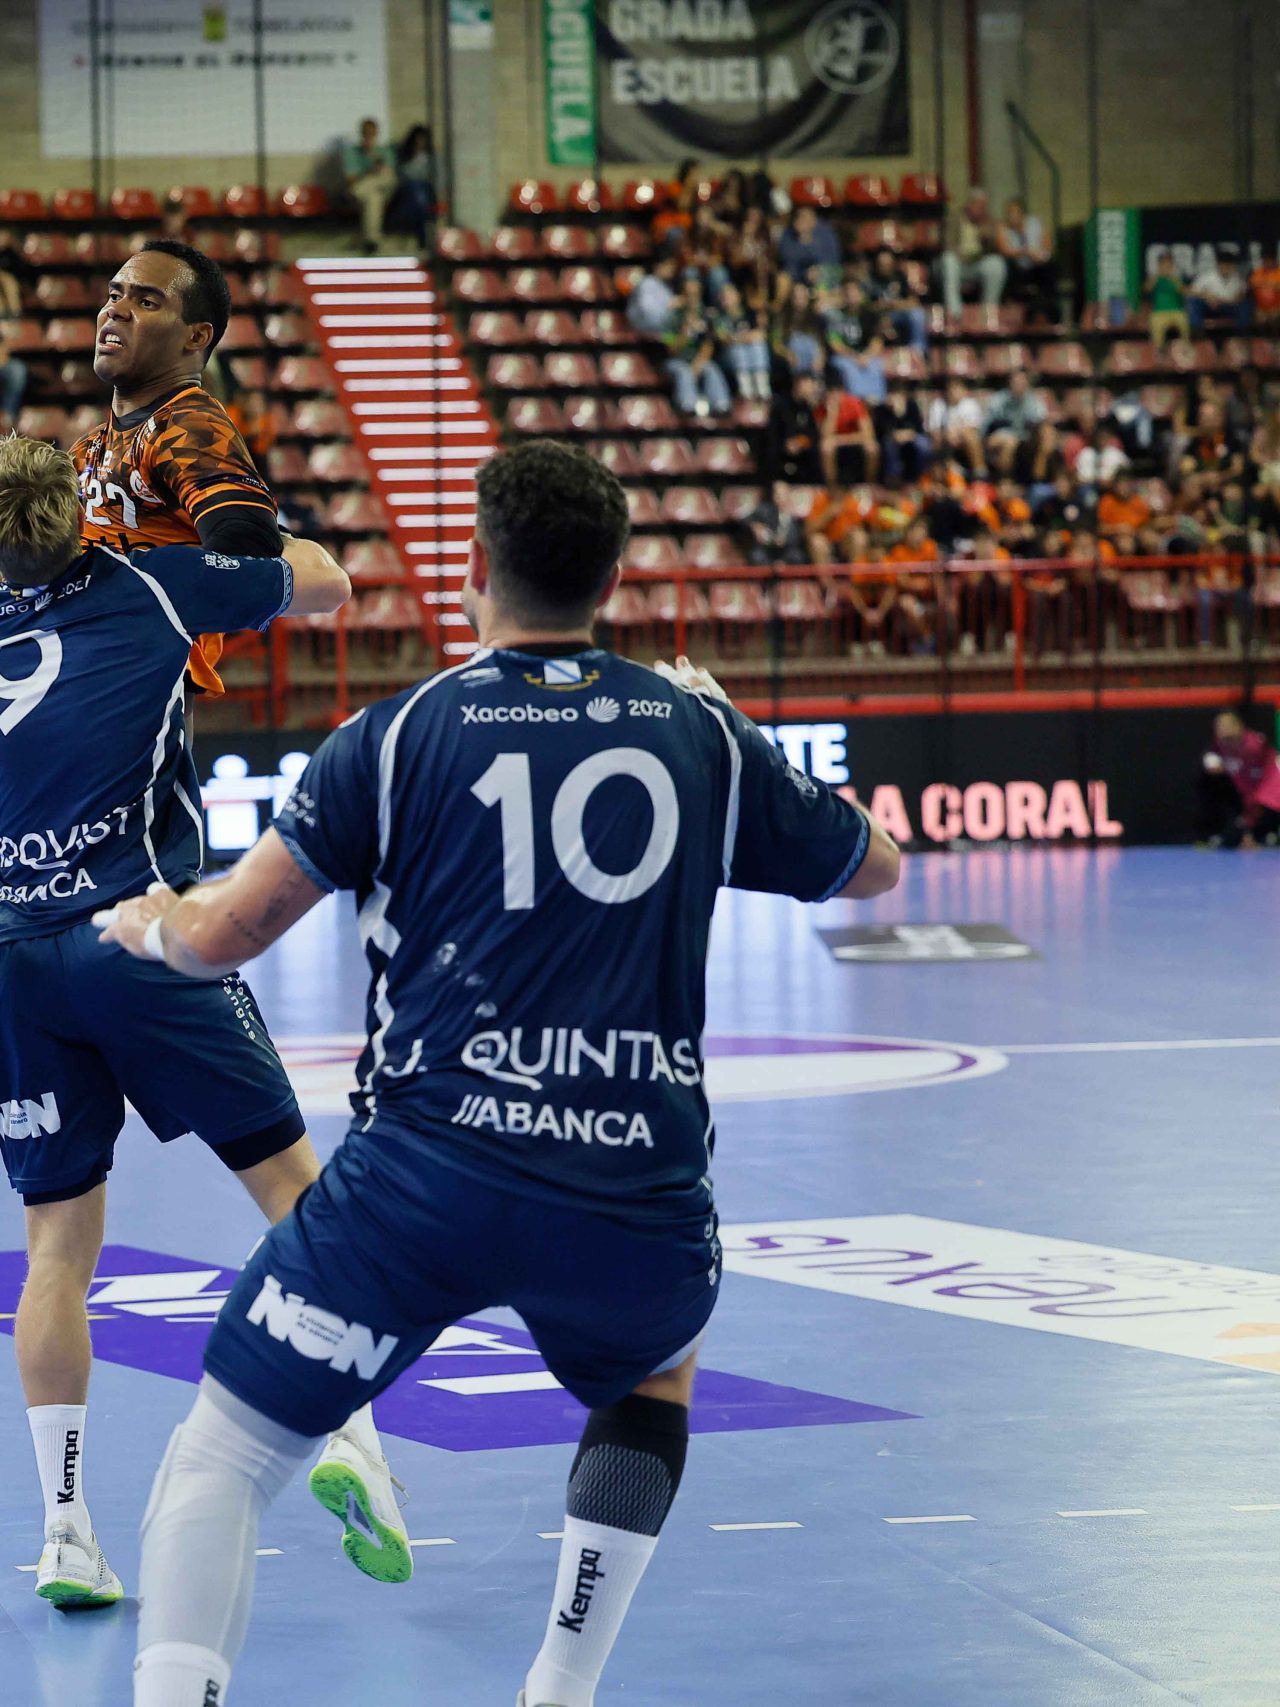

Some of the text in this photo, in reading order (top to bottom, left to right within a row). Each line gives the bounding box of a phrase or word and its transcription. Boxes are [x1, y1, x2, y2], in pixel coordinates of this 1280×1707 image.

[612, 56, 801, 106] ESCUELA
[84, 478, 139, 529] 27
[459, 699, 673, 725] Xacobeo 2027
[469, 746, 680, 911] 10
[920, 779, 1124, 842] CORAL
[460, 1026, 702, 1092] QUINTAS
[57, 1430, 80, 1505] Kempa
[557, 1547, 606, 1635] Kempa
